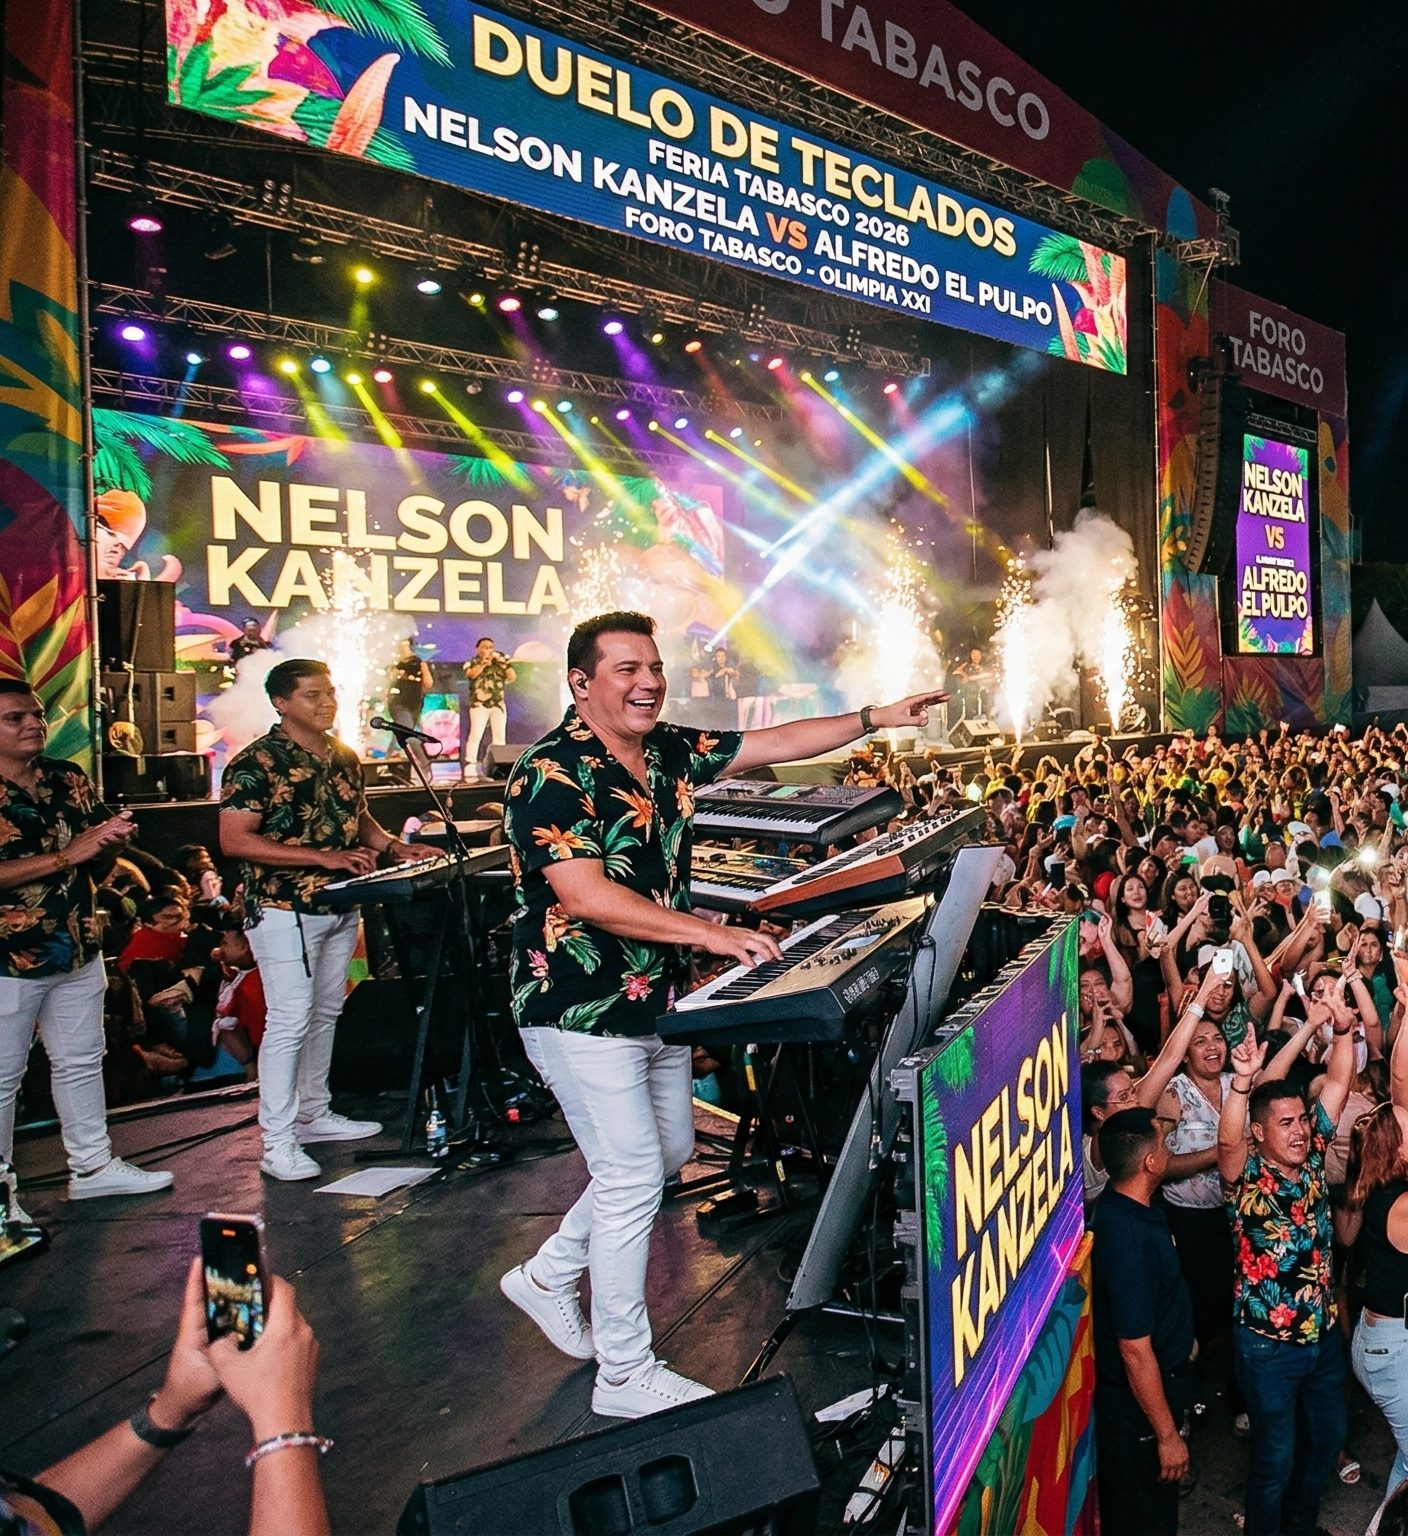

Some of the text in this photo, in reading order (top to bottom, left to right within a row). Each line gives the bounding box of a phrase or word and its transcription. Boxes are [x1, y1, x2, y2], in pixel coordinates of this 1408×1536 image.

[820, 0, 1050, 140] TABASCO
[473, 14, 1016, 257] DUELO DE TECLADOS
[404, 96, 1052, 326] NELSON KANZELA VS ALFREDO EL PULPO
[649, 139, 910, 247] FERIA TABASCO 2026
[625, 206, 695, 244] FORO
[698, 228, 802, 275] TABASCO
[819, 264, 899, 305] OLIMPIA
[901, 290, 931, 314] XXI
[1228, 335, 1324, 394] TABASCO
[1249, 310, 1306, 356] FORO
[210, 475, 565, 562] NELSON
[1243, 488, 1306, 523] KANZELA
[1244, 460, 1303, 499] NELSON
[1265, 524, 1285, 549] VS
[206, 544, 570, 615] KANZELA
[1242, 565, 1307, 595] ALFREDO
[1242, 590, 1308, 619] EL PULPO
[954, 1011, 1069, 1260] NELSON
[951, 1102, 1074, 1388] KANZELA
